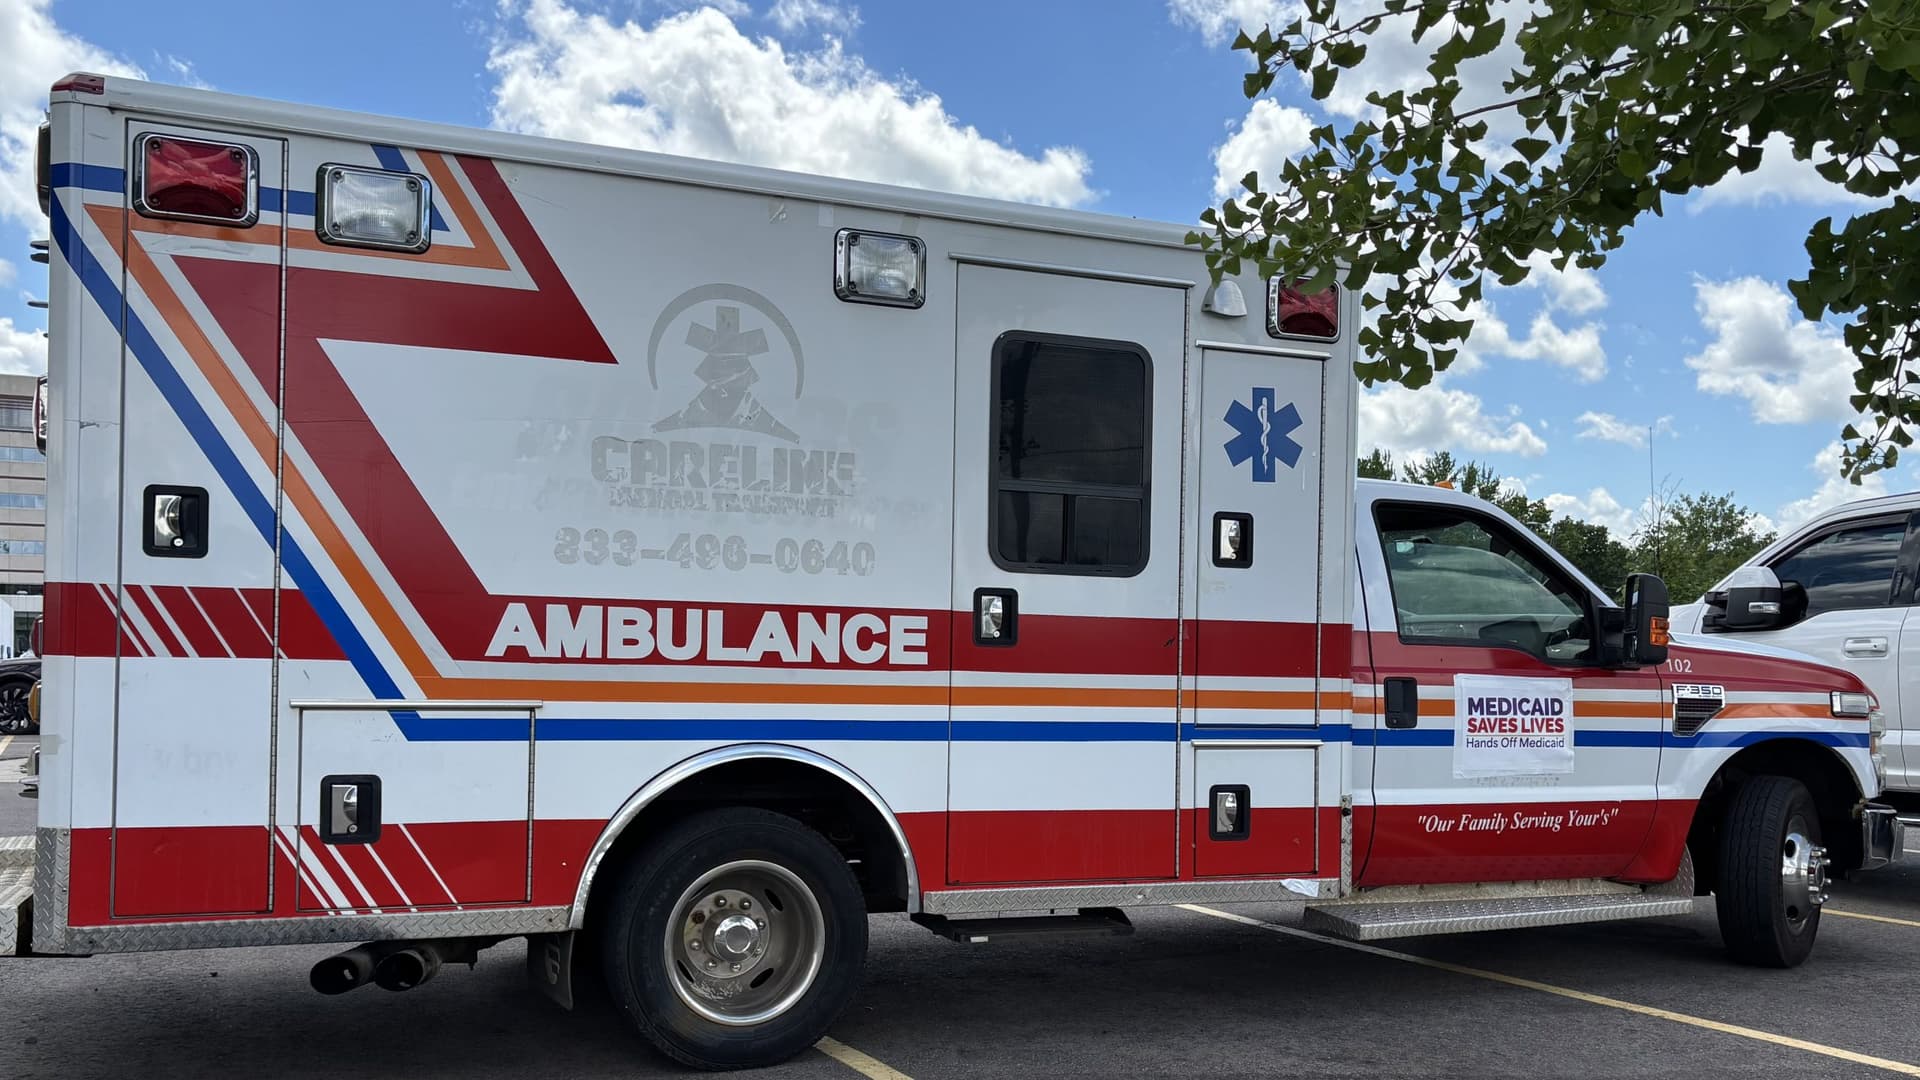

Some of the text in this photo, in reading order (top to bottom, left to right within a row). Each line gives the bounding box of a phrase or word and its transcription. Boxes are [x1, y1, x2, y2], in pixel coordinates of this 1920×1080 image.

[485, 602, 929, 666] AMBULANCE
[1666, 658, 1692, 673] 102
[1467, 697, 1564, 716] MEDICAID
[1467, 717, 1564, 733] SAVES LIVES
[1466, 737, 1565, 748] Hands Off Medicaid
[1417, 807, 1619, 834] "Our Family Serving Your's"
